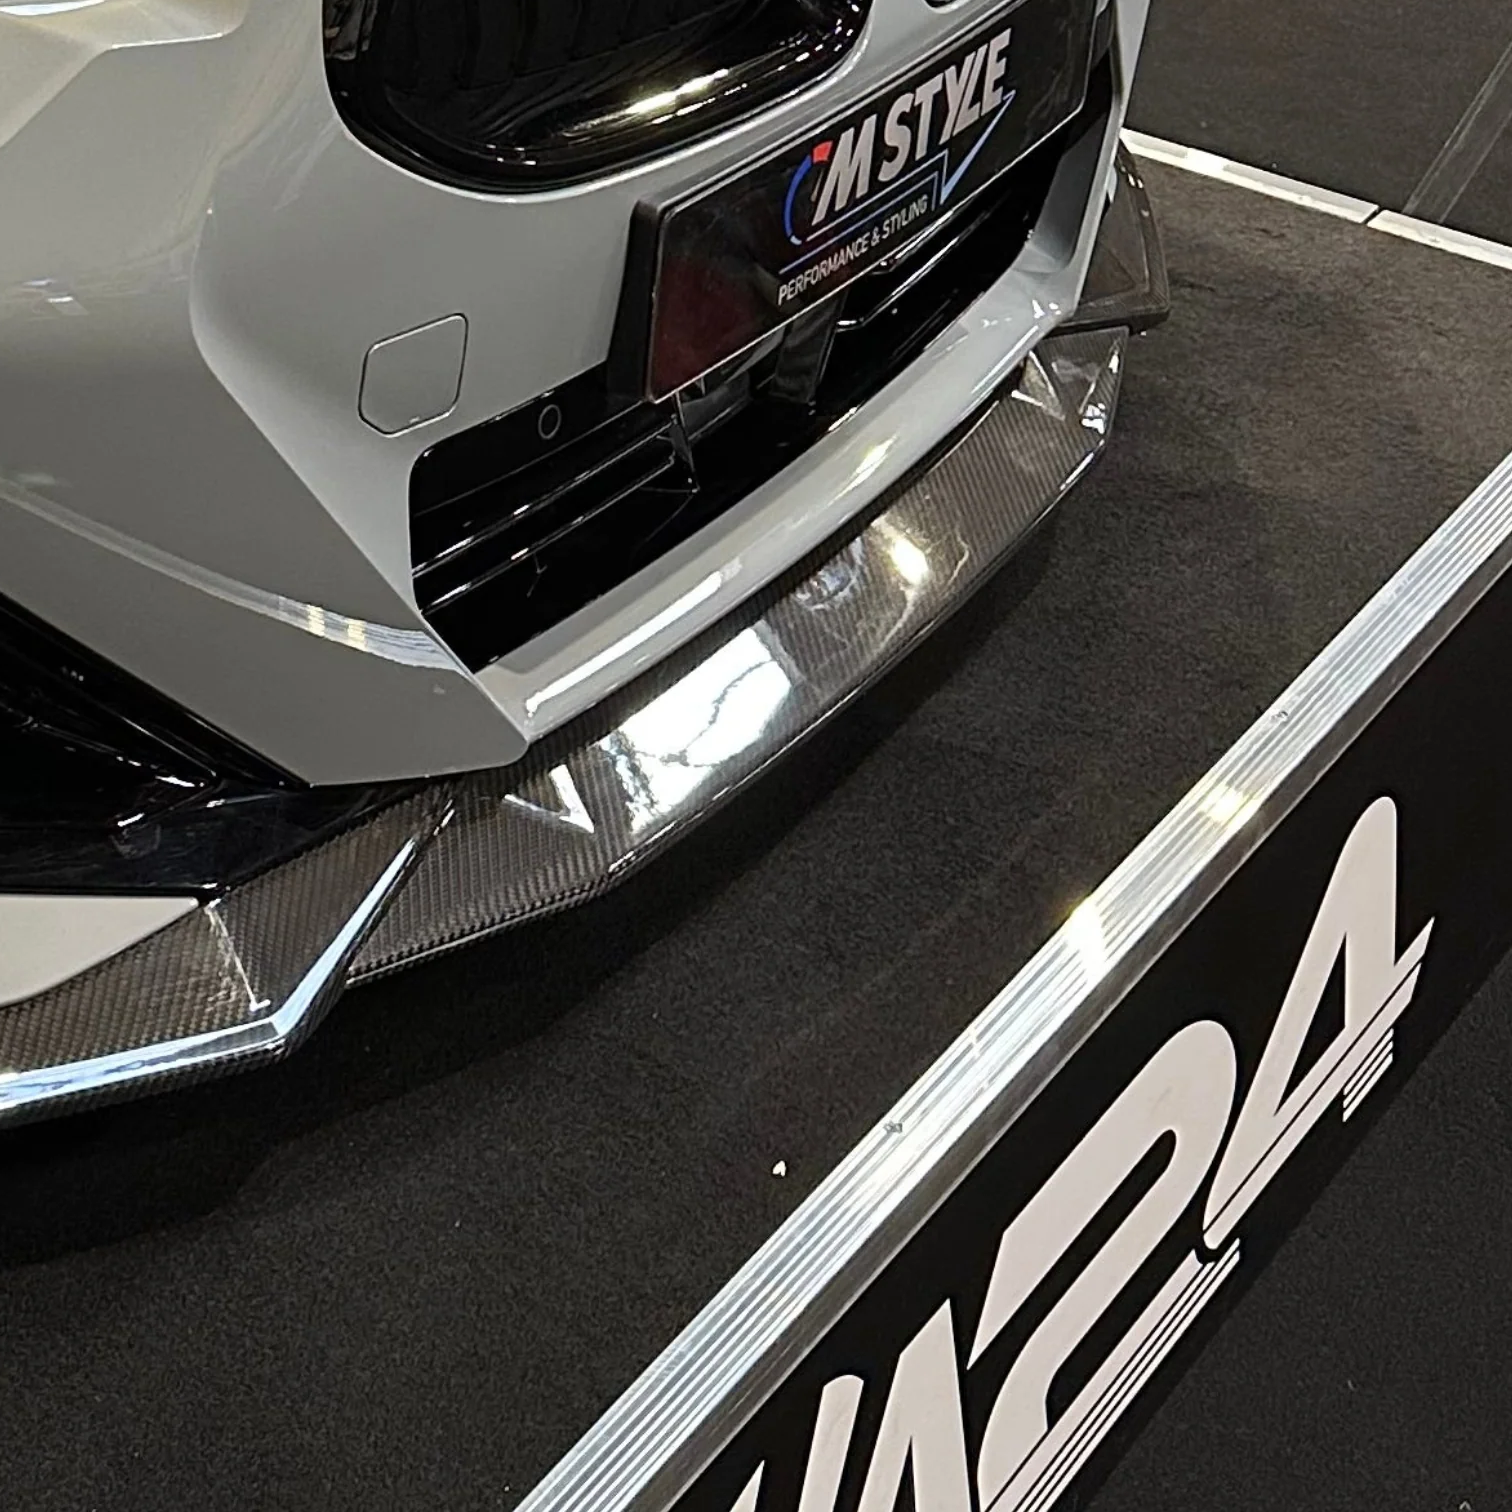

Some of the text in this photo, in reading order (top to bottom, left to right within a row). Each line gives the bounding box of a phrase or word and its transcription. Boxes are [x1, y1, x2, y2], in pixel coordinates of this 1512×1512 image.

[777, 194, 929, 306] PERFORMANCE & STYLING
